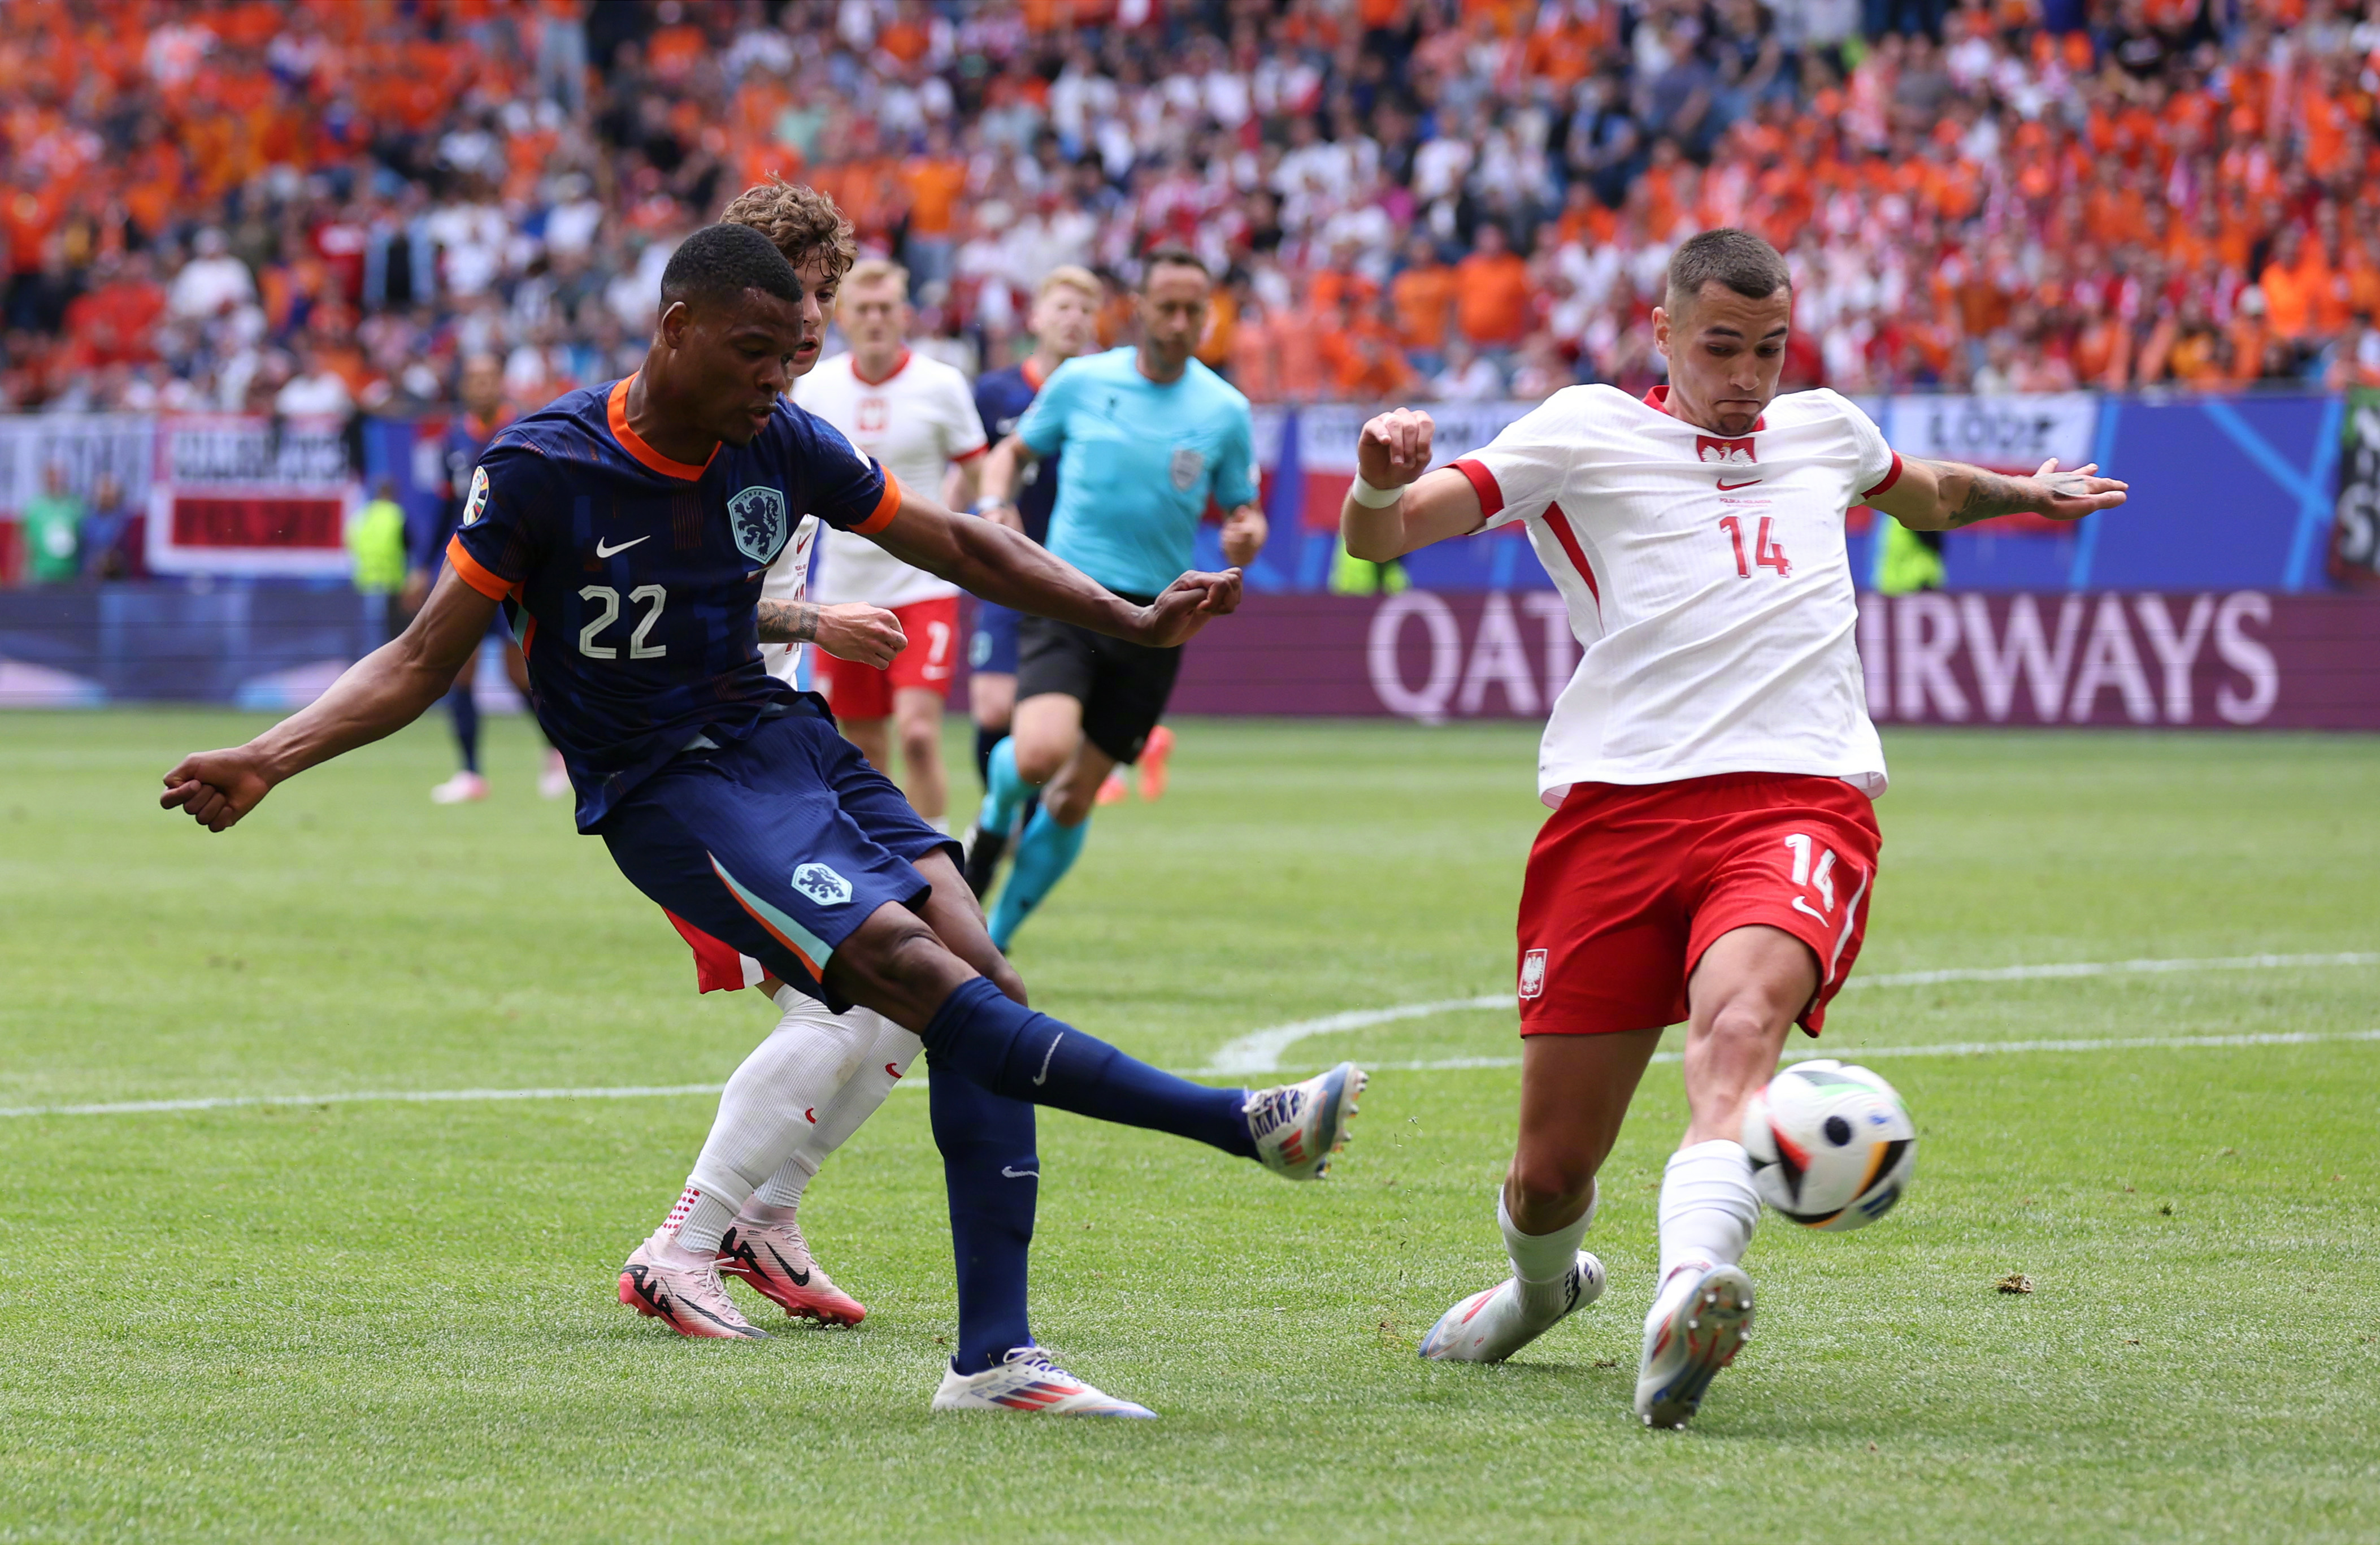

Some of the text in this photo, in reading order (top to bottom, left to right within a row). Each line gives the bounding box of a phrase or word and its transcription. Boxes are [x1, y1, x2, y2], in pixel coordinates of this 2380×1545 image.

[1719, 515, 1792, 579] 14
[577, 584, 667, 659] 22
[1366, 589, 2279, 726] QAT IRWAYS
[1784, 833, 1836, 913] 14
